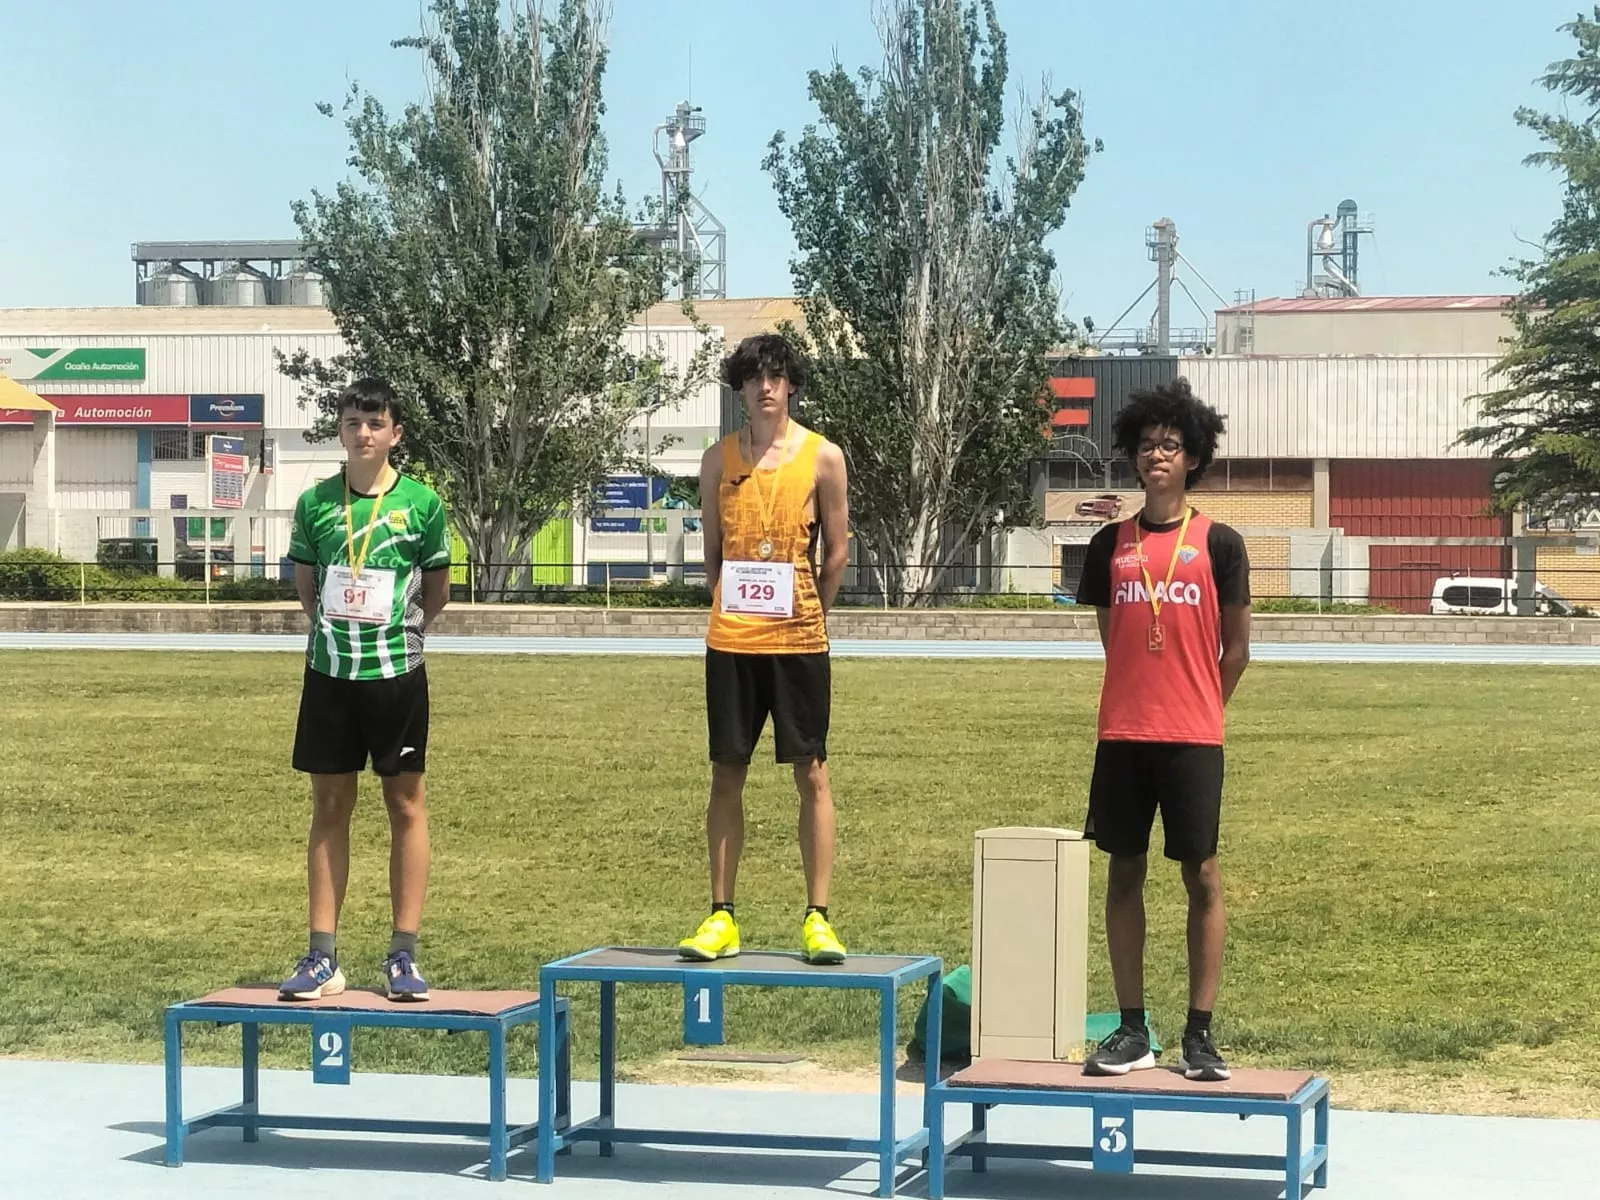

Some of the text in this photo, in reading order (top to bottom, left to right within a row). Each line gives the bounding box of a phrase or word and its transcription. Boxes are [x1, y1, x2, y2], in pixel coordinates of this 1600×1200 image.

[92, 361, 139, 371] Automoción
[74, 406, 152, 419] Automoción
[343, 588, 367, 606] 91
[737, 583, 775, 601] 129
[693, 988, 711, 1023] 1
[319, 1032, 343, 1066] 2
[1100, 1116, 1127, 1153] 3
